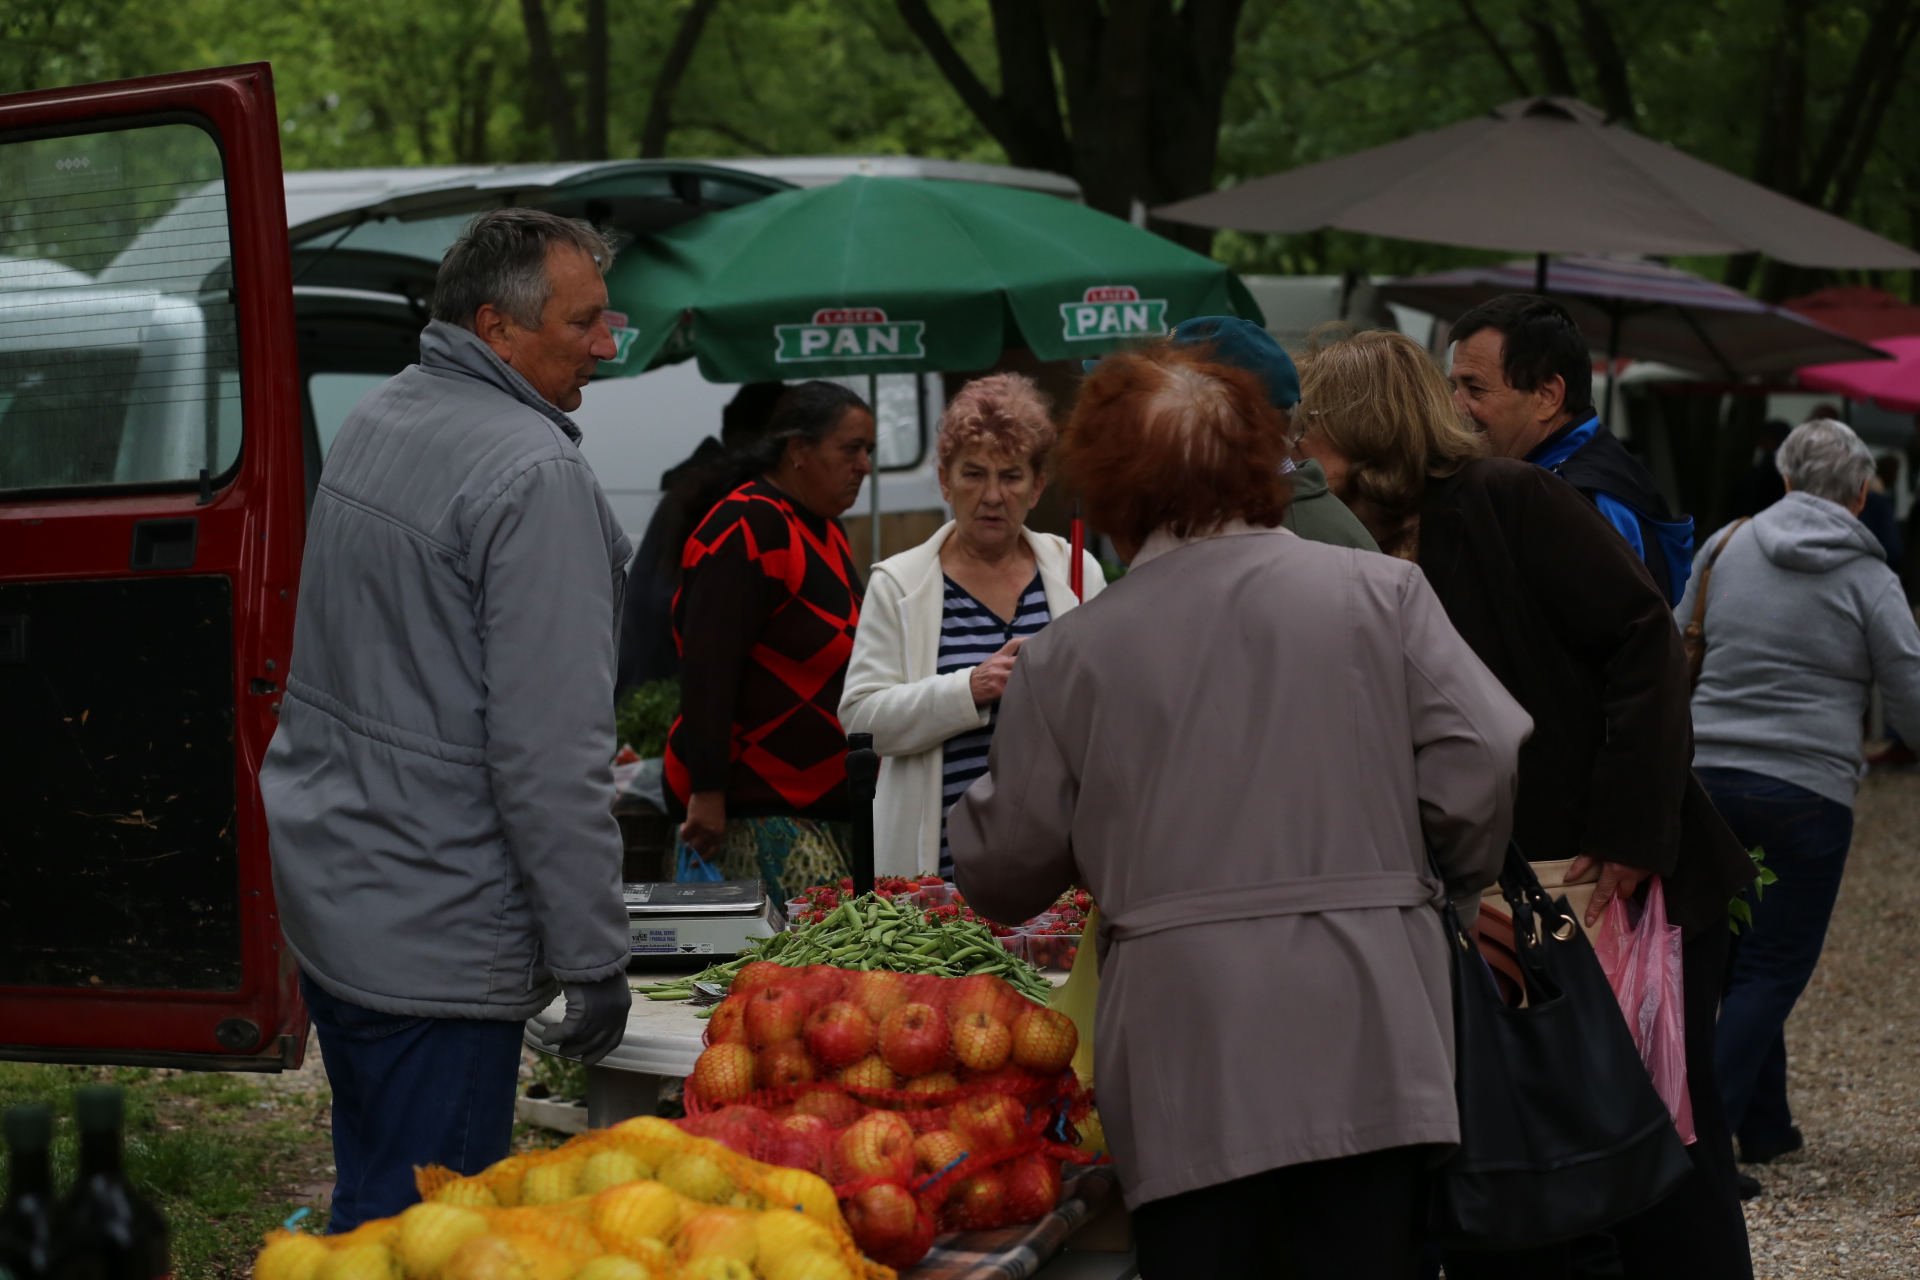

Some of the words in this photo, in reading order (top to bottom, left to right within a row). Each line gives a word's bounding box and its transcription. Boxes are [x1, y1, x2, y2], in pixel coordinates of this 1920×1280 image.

[823, 311, 876, 322] LAGER
[1075, 304, 1149, 335] PAN
[800, 326, 900, 356] PAN
